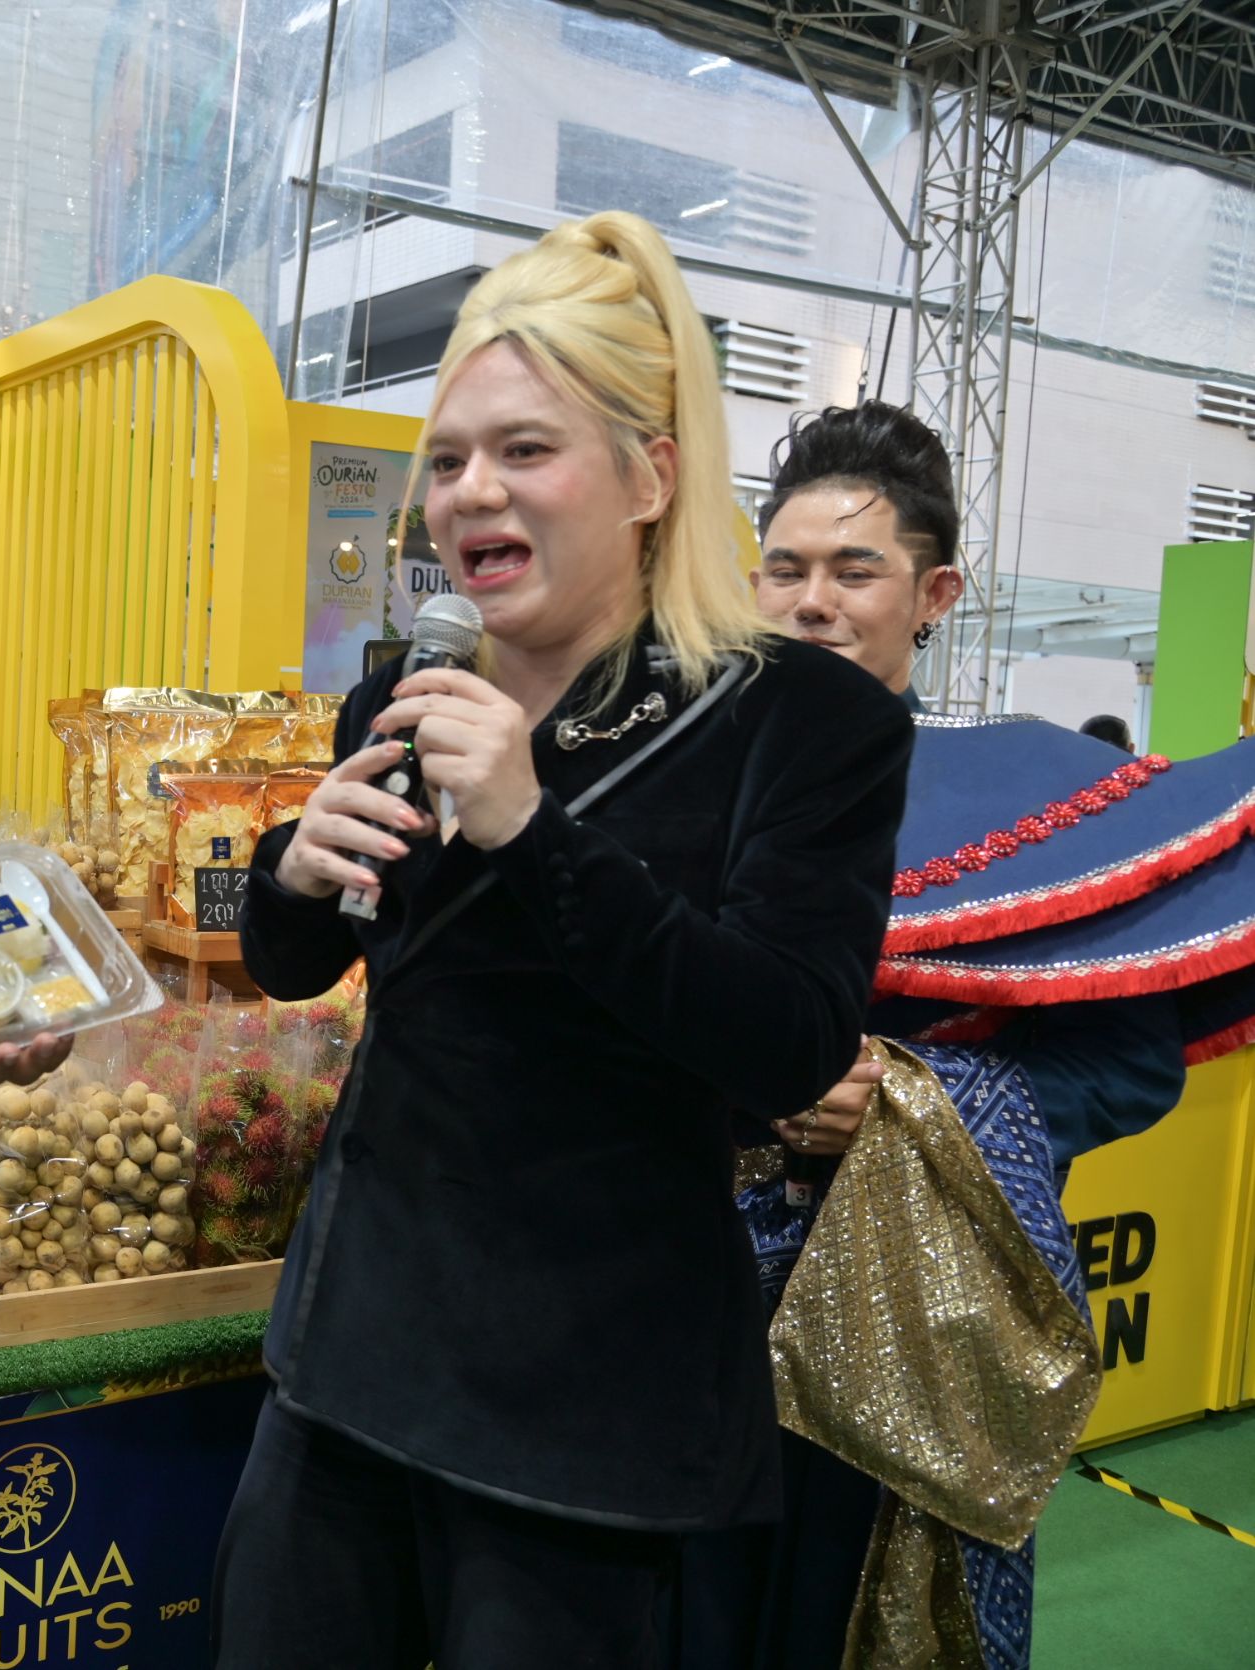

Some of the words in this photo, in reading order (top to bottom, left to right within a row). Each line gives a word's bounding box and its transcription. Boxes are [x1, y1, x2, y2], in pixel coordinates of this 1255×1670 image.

[333, 456, 367, 466] PREMIUM
[411, 567, 458, 593] DUR
[322, 584, 372, 599] DURIAN
[796, 1187, 806, 1201] 3
[159, 1598, 200, 1621] 1990
